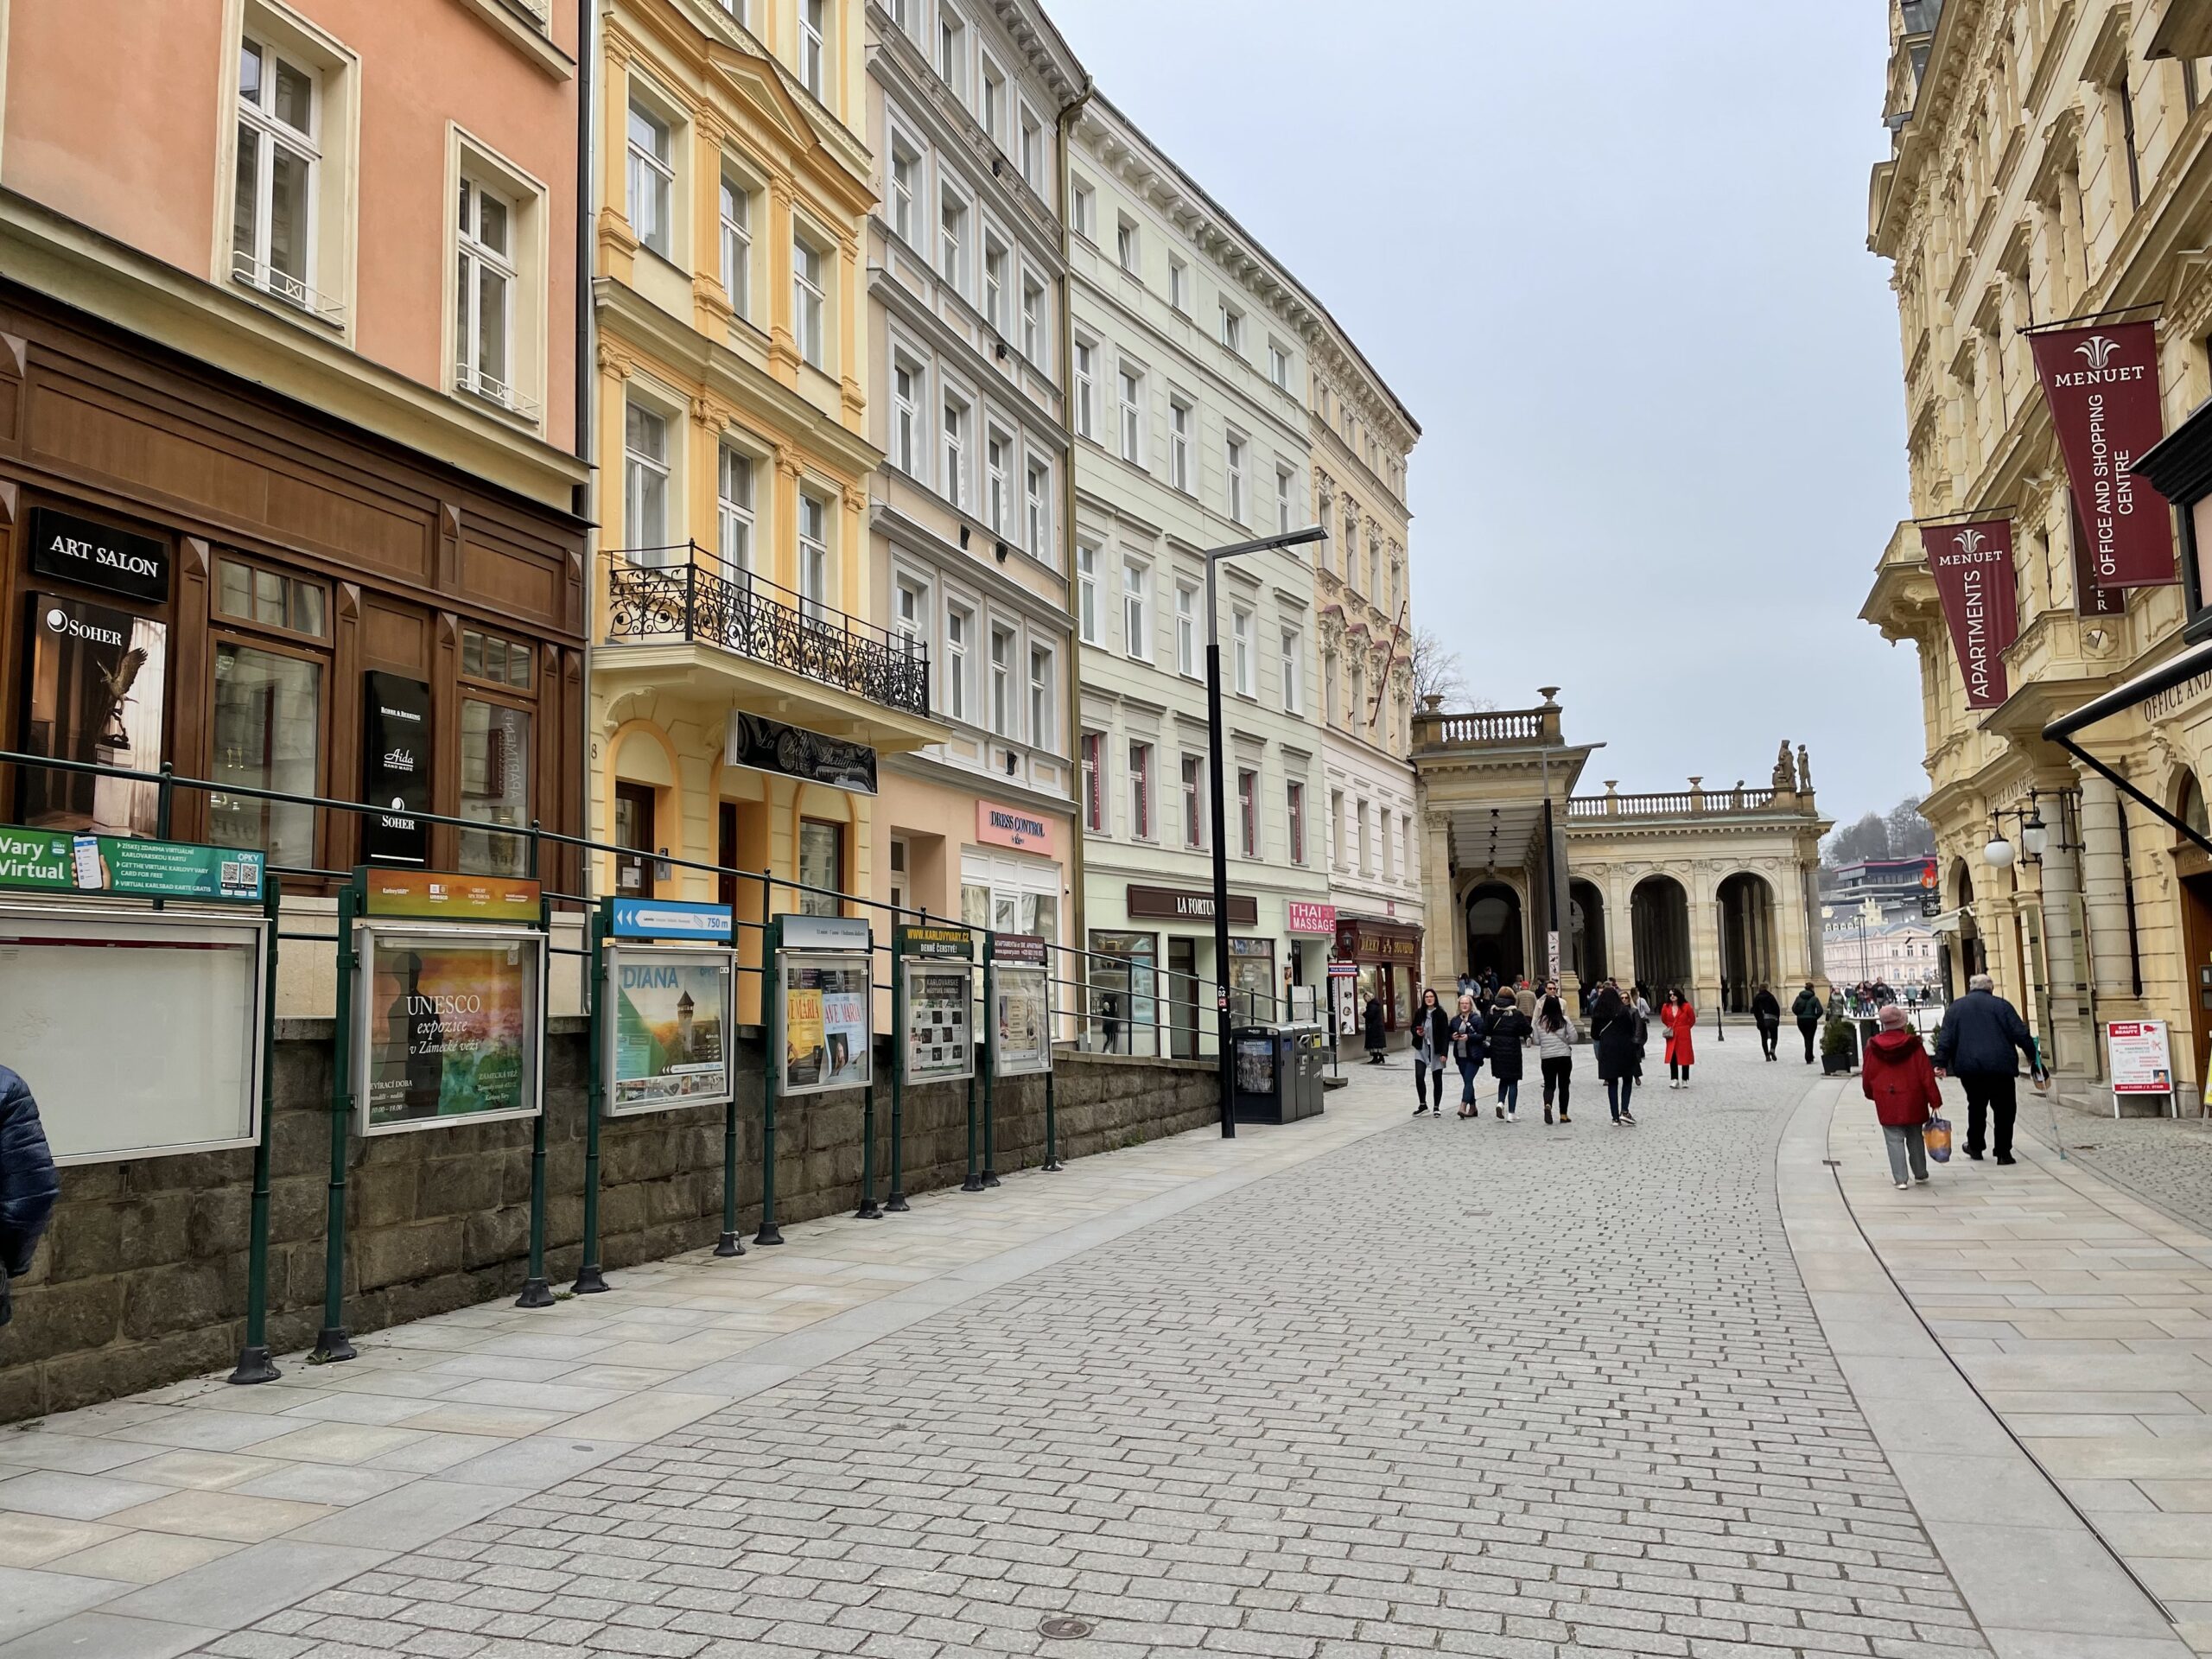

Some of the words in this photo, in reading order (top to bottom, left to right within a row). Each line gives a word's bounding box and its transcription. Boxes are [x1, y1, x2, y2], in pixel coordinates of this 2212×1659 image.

[2055, 365, 2145, 388] MENUET
[2088, 394, 2108, 476] SHOPPING
[2114, 449, 2133, 515] CENTRE
[2095, 480, 2112, 514] AND
[49, 535, 92, 560] ART
[96, 547, 159, 578] SALON
[2098, 517, 2116, 575] OFFICE
[1939, 550, 2003, 566] MENUET
[68, 619, 123, 646] SOHER
[1964, 569, 1990, 698] APARTMENTS
[2144, 683, 2183, 722] OFFICE
[591, 743, 597, 760] 8
[783, 732, 811, 759] Belle
[384, 748, 414, 765] Aida
[382, 815, 415, 830] SOHER
[990, 810, 1014, 830] DRESS
[1014, 817, 1046, 837] CONTROL
[0, 836, 44, 861] Vary
[122, 852, 167, 861] KARLOVARSKOU
[238, 853, 258, 861] OPKV
[0, 859, 65, 880] Virtual
[1177, 897, 1187, 913] LA
[1188, 898, 1215, 915] FORTUN
[1290, 903, 1322, 918] THAI
[707, 918, 720, 928] 750
[1293, 917, 1335, 931] MASSAGE
[906, 928, 969, 943] WWW.KARLOVYVARY.CZ
[622, 966, 679, 988] DIANA
[406, 995, 480, 1016] UNESCO
[825, 1004, 840, 1024] AVE
[841, 1002, 861, 1022] MARIA
[416, 1016, 468, 1040] expozice
[410, 1045, 416, 1054] v
[419, 1039, 458, 1054] Zámecké
[395, 1079, 413, 1089] DOBA
[479, 1071, 506, 1080] ZÁMECKÁ
